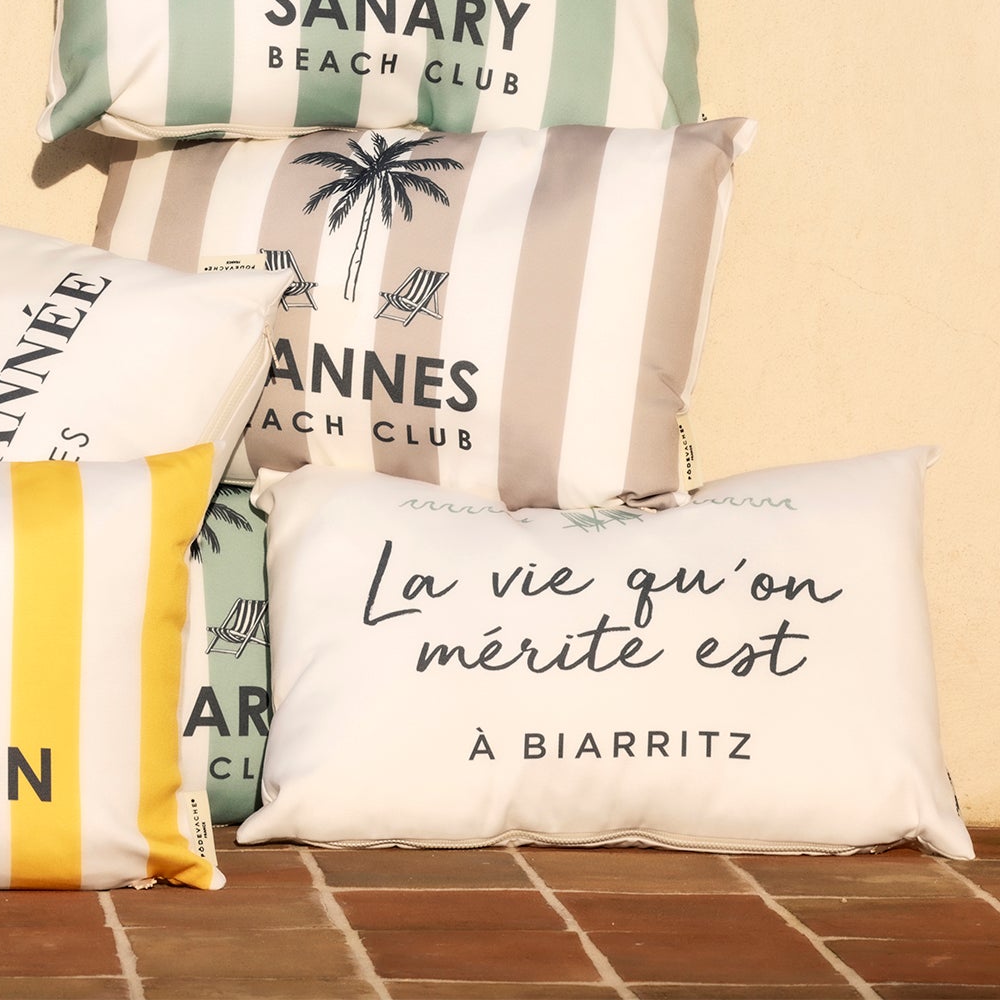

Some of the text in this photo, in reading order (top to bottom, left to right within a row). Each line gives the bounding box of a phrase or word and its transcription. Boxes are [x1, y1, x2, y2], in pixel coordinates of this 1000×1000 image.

[268, 45, 519, 95] BEACH CLUB
[246, 408, 472, 451] ACH CLUB
[363, 539, 844, 628] La vie qu'on
[415, 613, 810, 677] mérite est
[183, 686, 269, 736] AR
[209, 756, 255, 780] CL
[468, 727, 751, 761] À BIARRITZ
